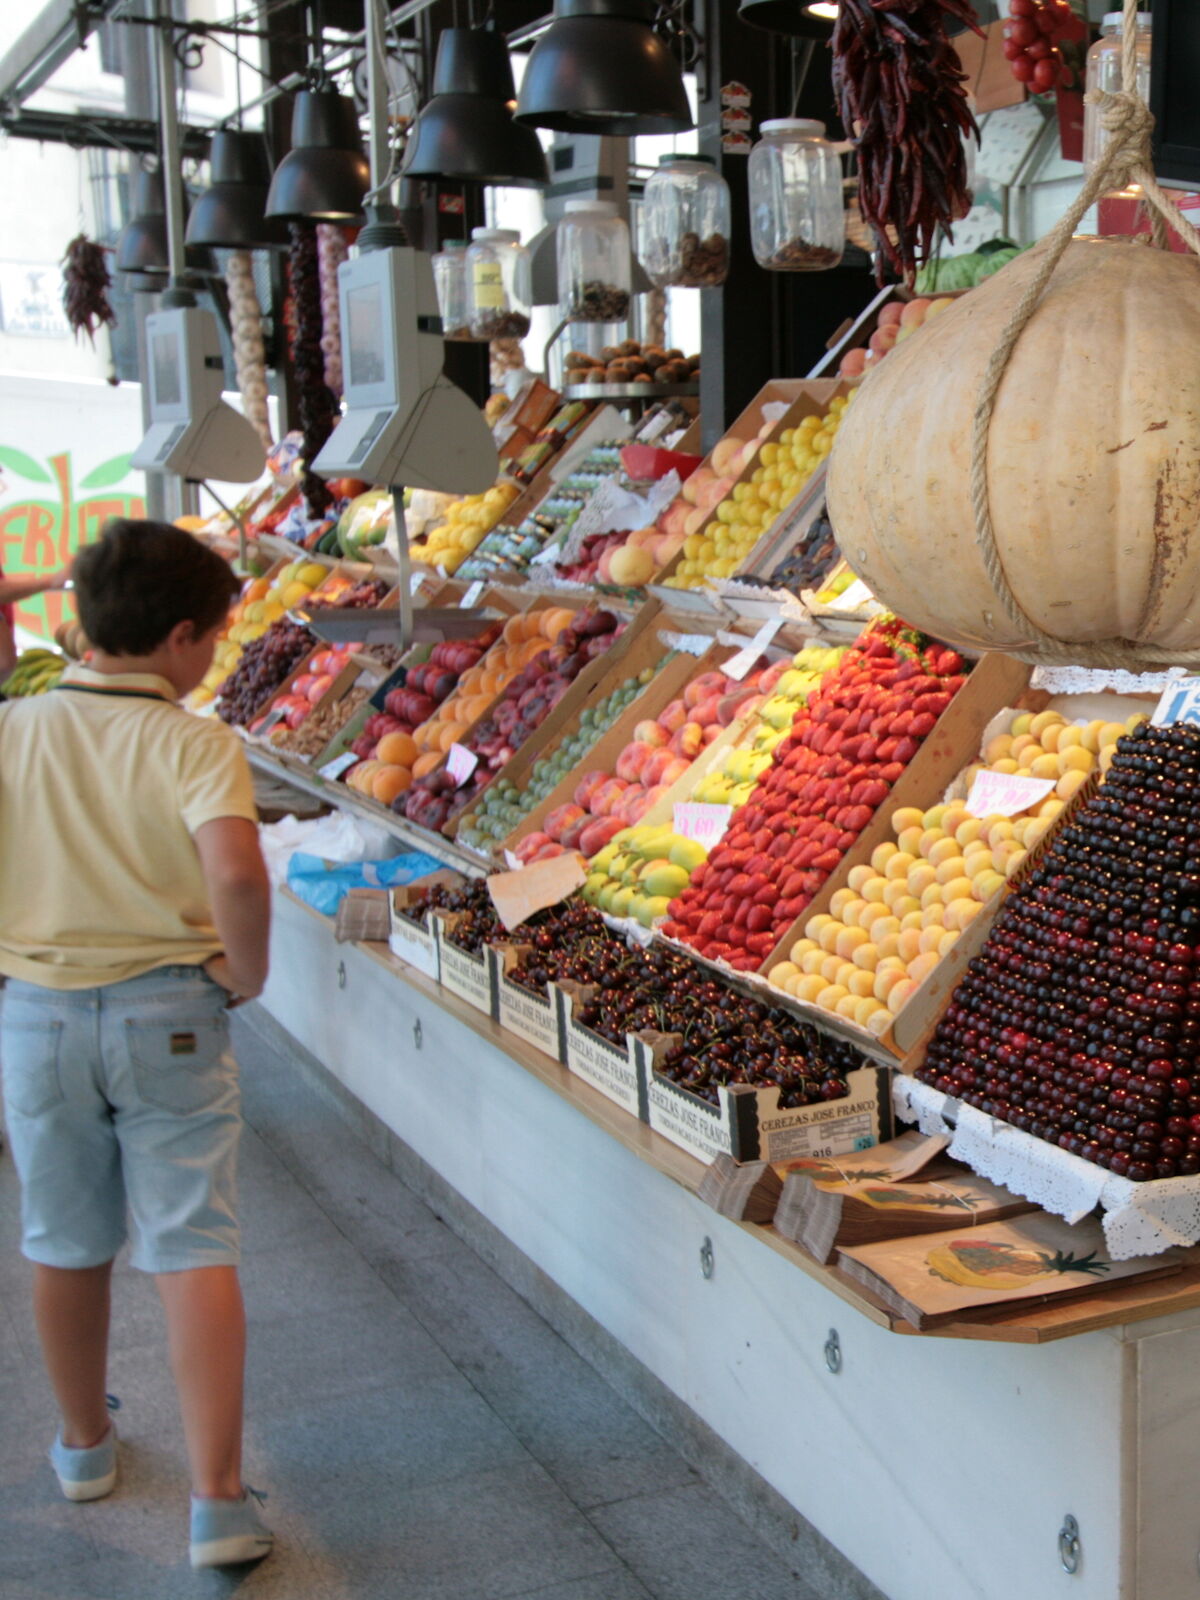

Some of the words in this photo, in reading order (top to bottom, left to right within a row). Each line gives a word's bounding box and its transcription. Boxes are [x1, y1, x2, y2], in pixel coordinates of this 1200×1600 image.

[680, 1106, 699, 1131] JOSE
[699, 1117, 731, 1149] FRANCO
[761, 1114, 809, 1131] CEREZAS
[811, 1110, 835, 1122] JOSE
[837, 1100, 875, 1117] FRANCO
[812, 1147, 832, 1158] 916
